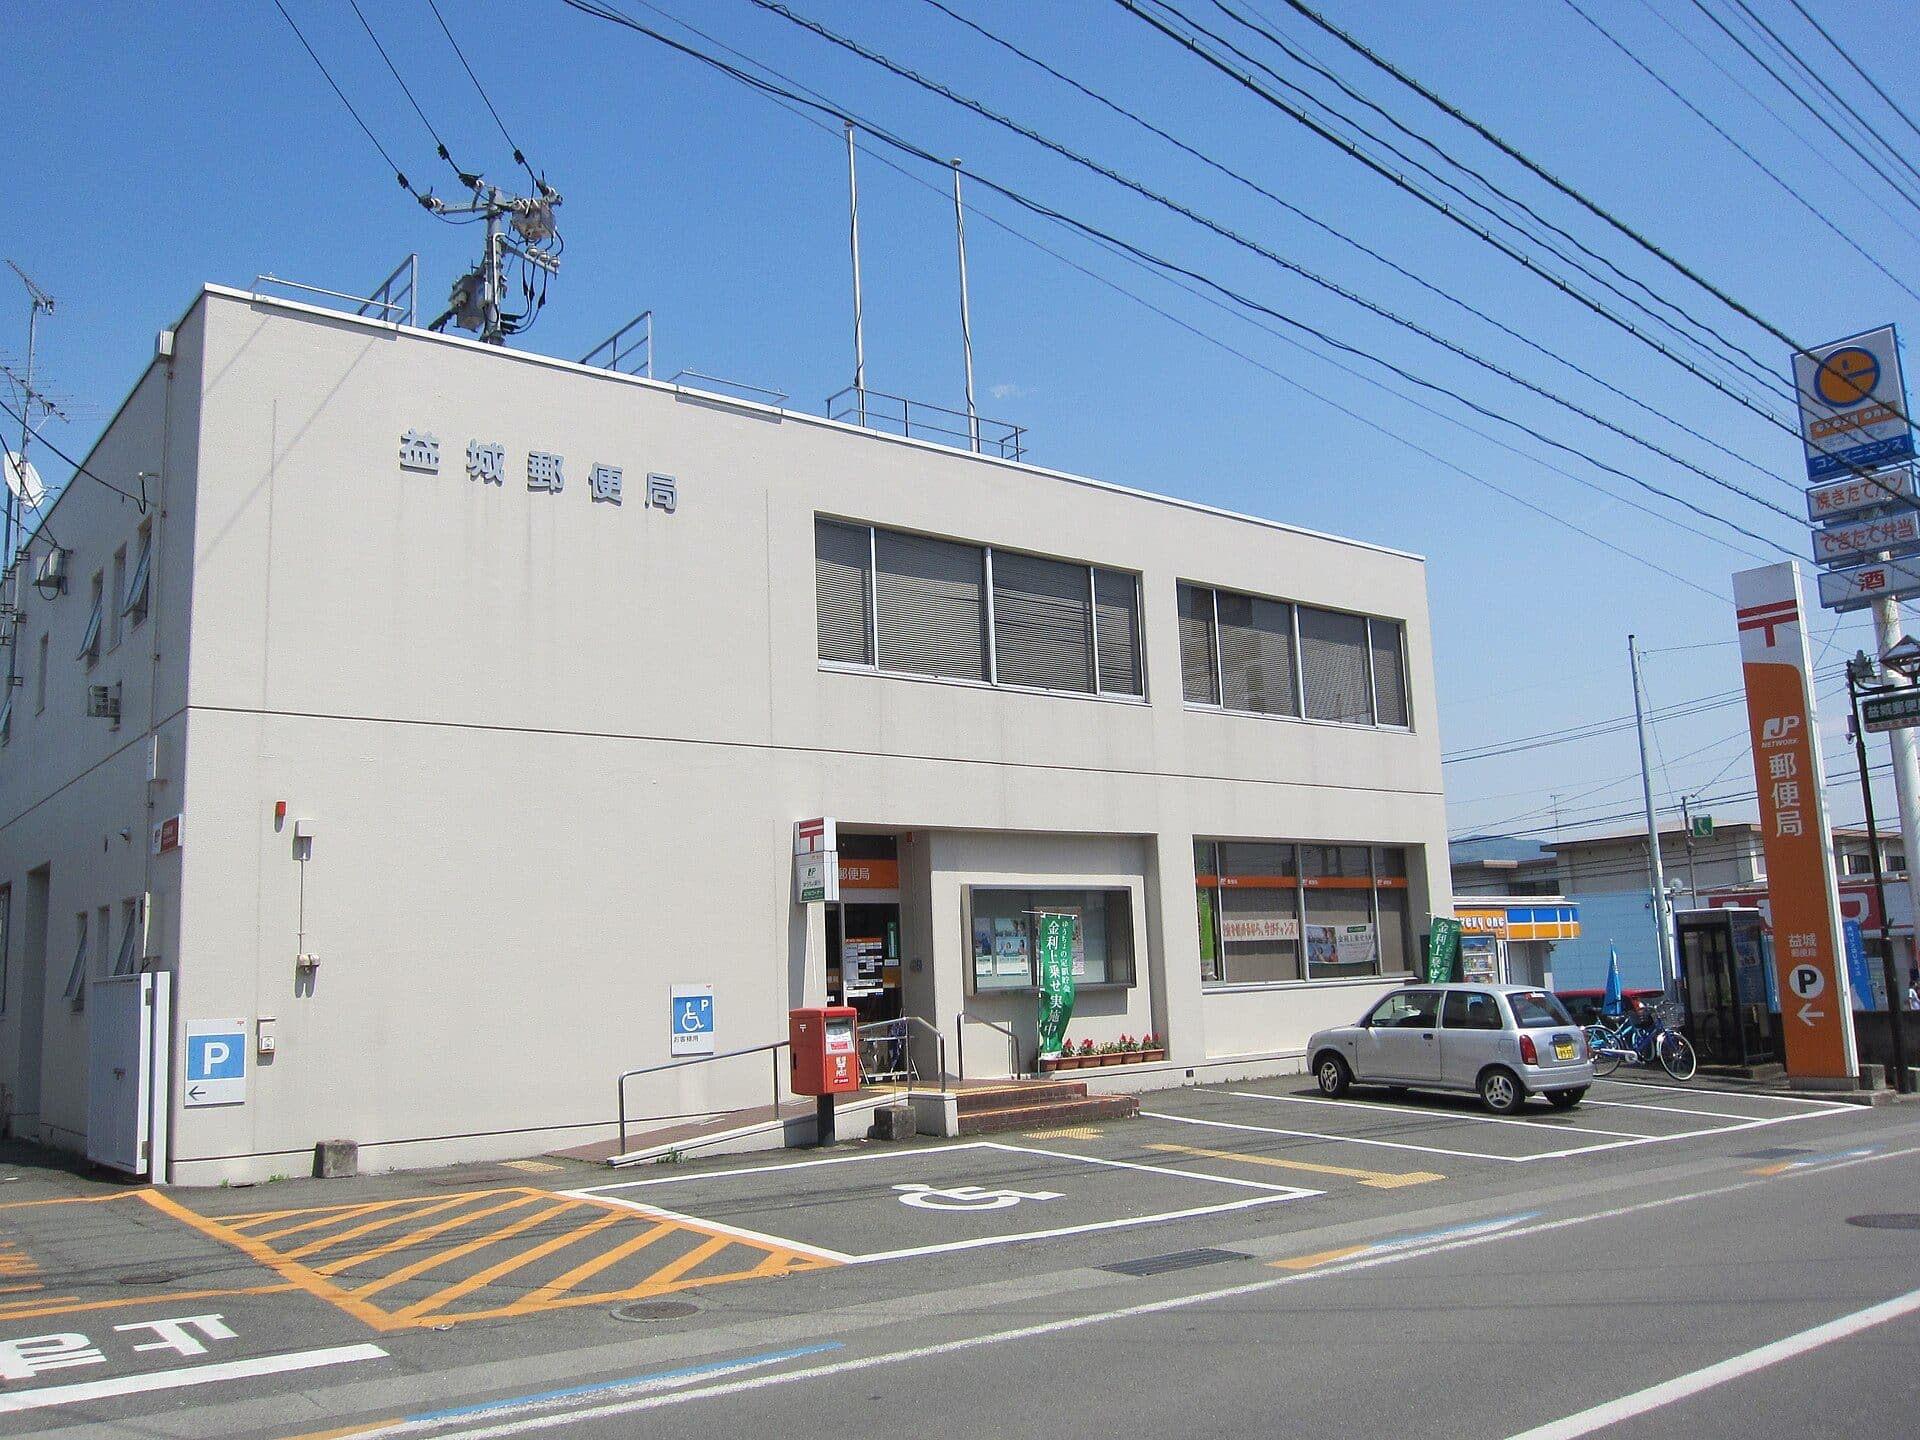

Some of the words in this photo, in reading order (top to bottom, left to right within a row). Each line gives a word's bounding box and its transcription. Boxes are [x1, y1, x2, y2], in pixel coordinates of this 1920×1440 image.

[399, 428, 678, 514] 益城郵便局
[1820, 519, 1914, 552] できたて弁当
[1857, 569, 1886, 593] 酒
[1866, 699, 1920, 719] 益城郵便
[1767, 752, 1803, 838] 郵便局
[1486, 916, 1505, 928] one
[1430, 921, 1449, 983] 金利上乗せ
[1798, 970, 1817, 994] P
[700, 999, 709, 1012] P
[203, 1042, 230, 1075] P
